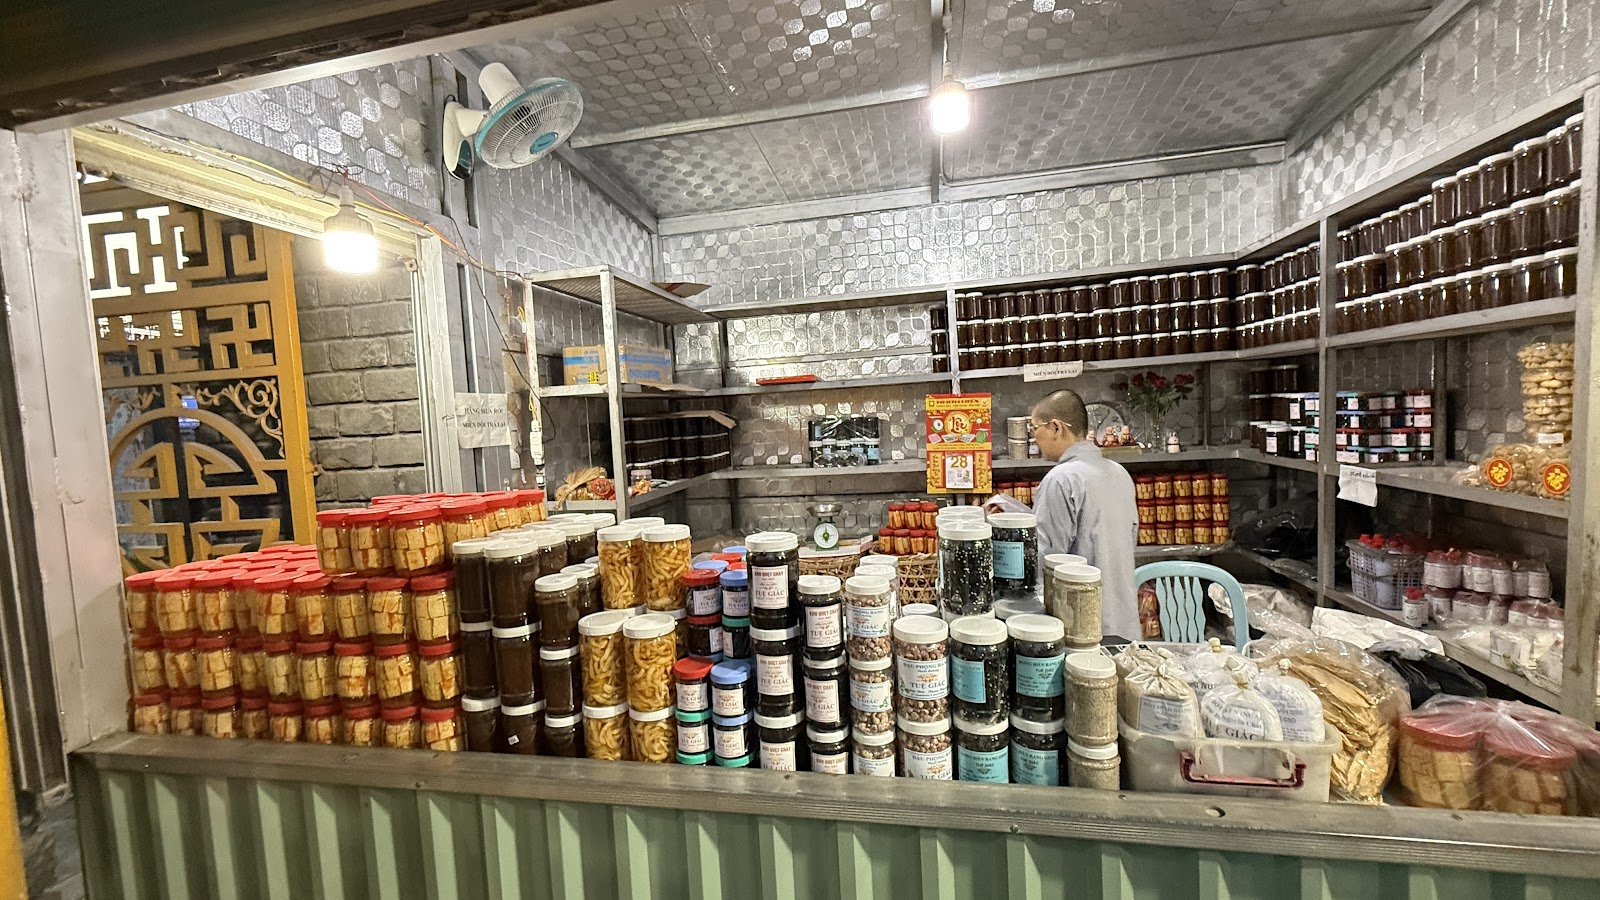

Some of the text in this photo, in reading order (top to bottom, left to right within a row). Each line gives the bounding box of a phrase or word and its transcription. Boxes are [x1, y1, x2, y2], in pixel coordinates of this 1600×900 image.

[951, 455, 968, 469] 28
[1490, 462, 1509, 483] 福
[1546, 467, 1568, 490] 福
